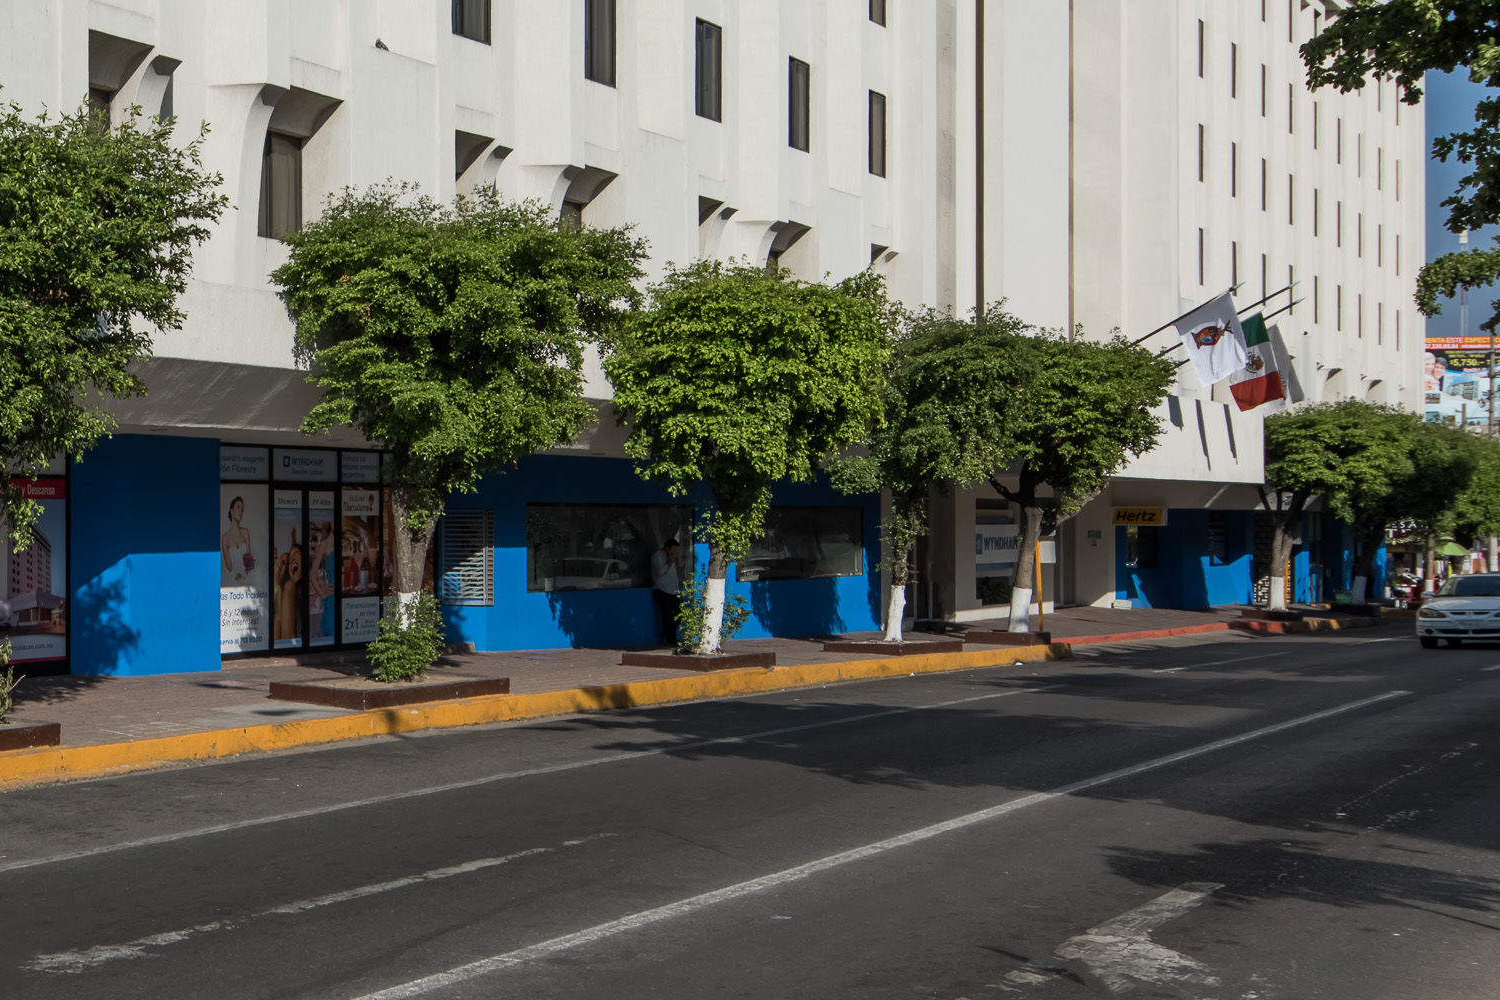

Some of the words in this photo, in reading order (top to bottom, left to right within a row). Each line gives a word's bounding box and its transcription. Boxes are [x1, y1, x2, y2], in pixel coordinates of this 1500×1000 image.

[27, 484, 56, 496] Descanso
[1116, 511, 1157, 522] Hertz
[345, 618, 359, 630] 2x1
